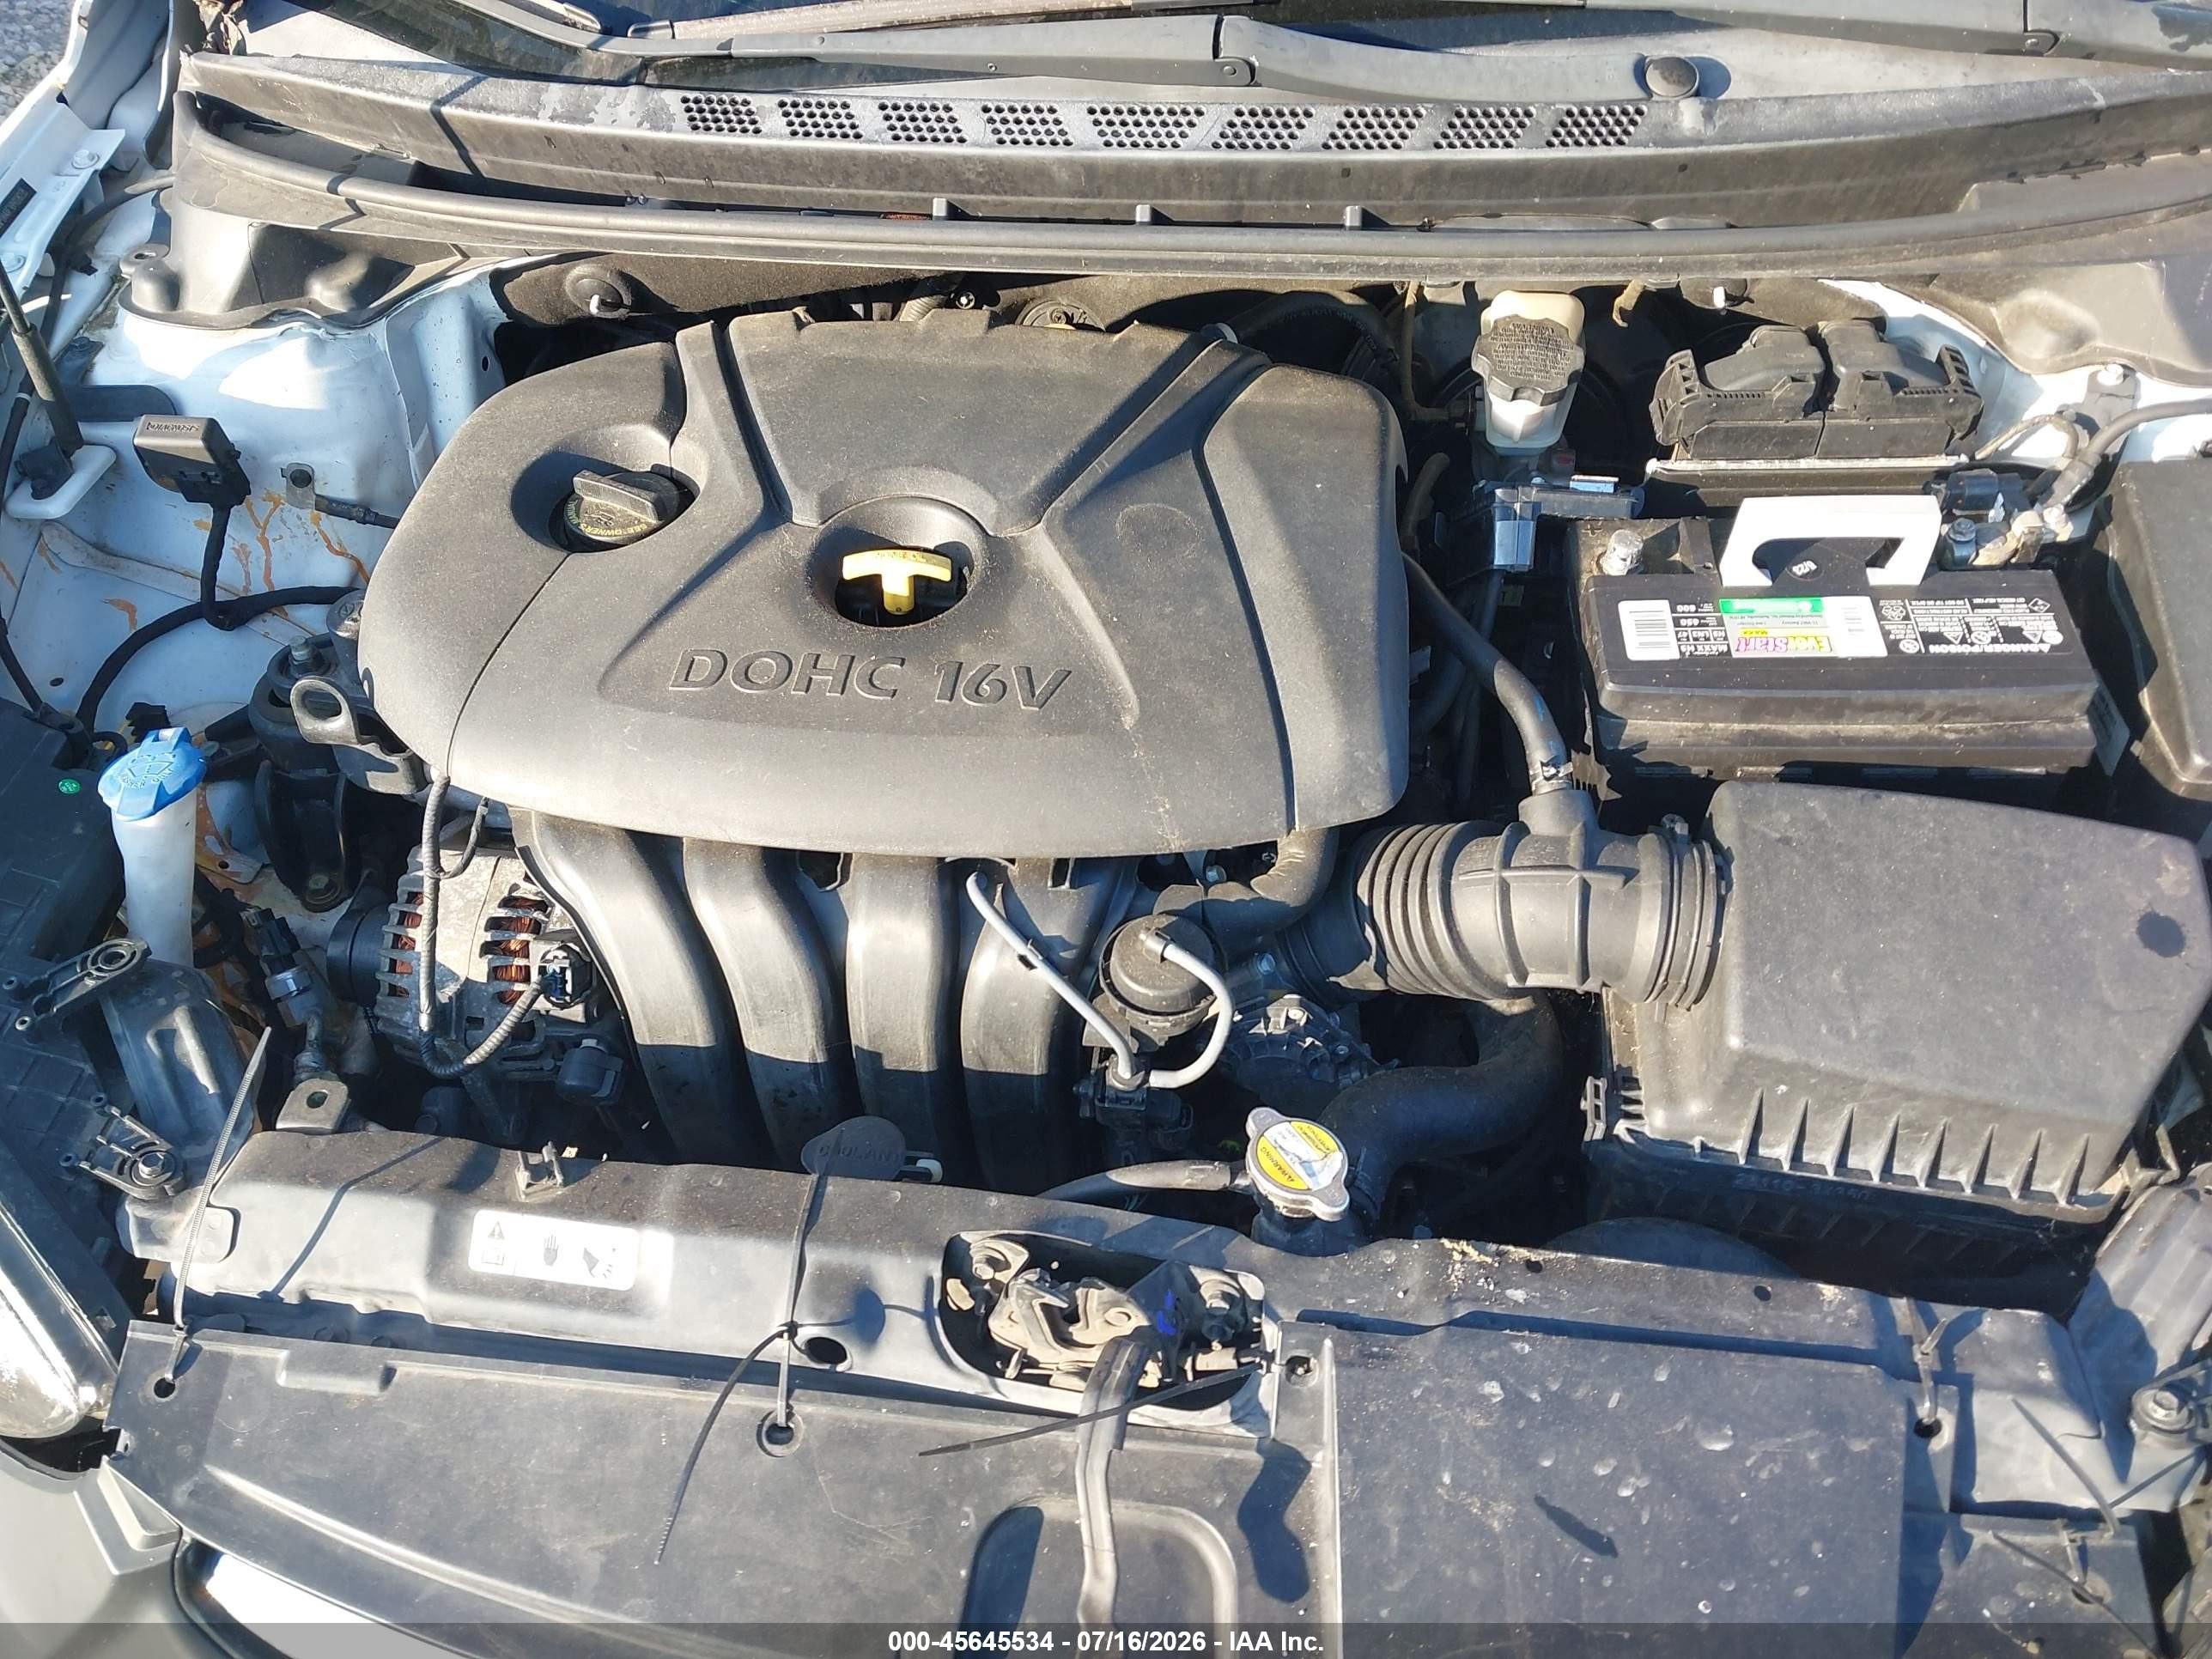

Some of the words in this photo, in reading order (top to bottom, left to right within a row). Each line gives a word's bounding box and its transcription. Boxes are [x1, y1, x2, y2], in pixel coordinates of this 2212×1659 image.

[568, 500, 580, 525] MANUAL
[627, 523, 647, 535] SEE
[669, 648, 906, 701] DOHC
[934, 660, 1073, 711] 16V
[818, 1146, 903, 1162] COLANT
[1261, 1146, 1291, 1182] WARNING
